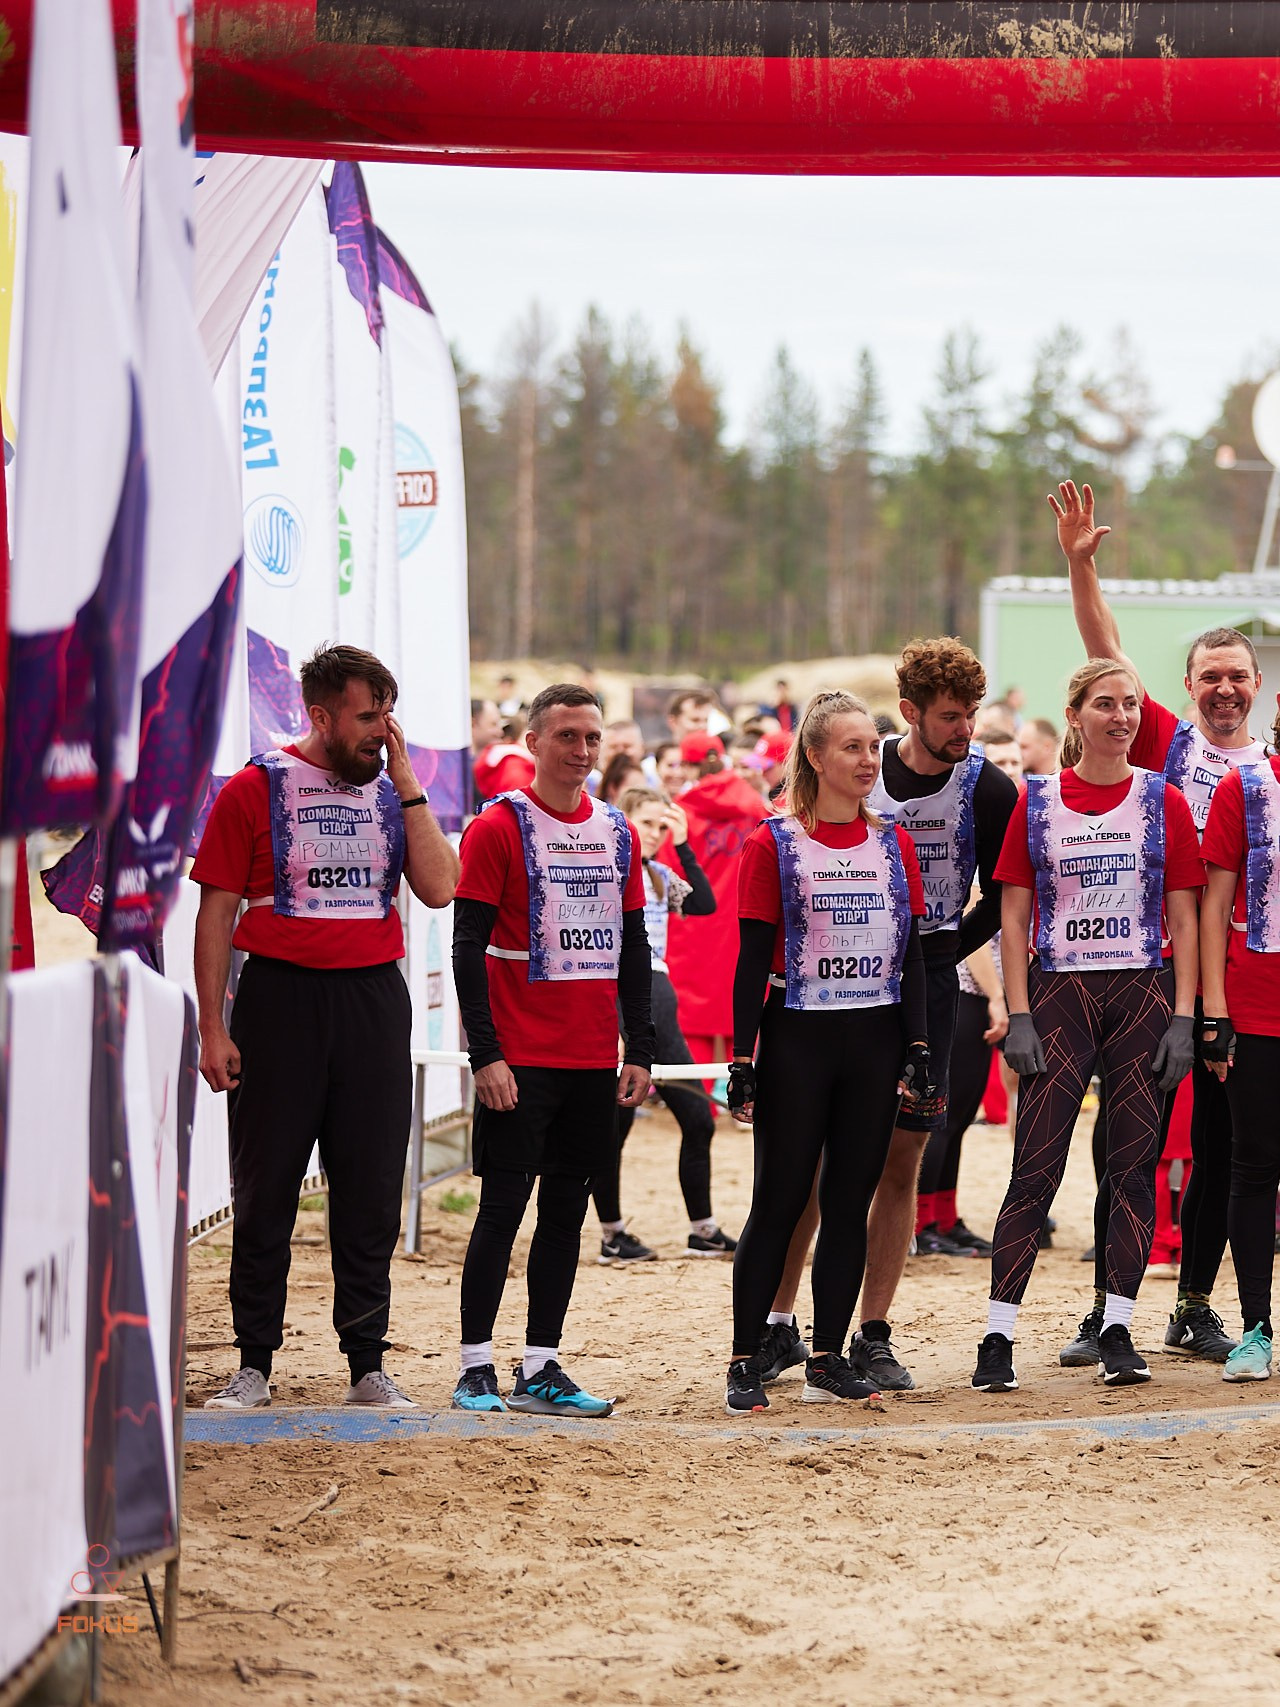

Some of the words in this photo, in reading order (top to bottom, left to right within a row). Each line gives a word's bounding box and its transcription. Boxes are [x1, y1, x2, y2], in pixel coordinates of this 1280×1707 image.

[300, 807, 371, 822] КОМАНДНЫЙ
[321, 822, 353, 834] СТАРТ
[910, 819, 945, 828] ГЕРОЕВ
[1062, 834, 1092, 844] ГОНКА
[1095, 832, 1131, 840] ГЕРОЕВ
[302, 842, 371, 861] РОМАН
[547, 843, 574, 851] ГОНКА
[576, 843, 606, 851] ГЕРОЕВ
[1062, 854, 1134, 875] КОМАНДНЫЙ
[307, 866, 371, 889] 03201
[550, 866, 612, 882] КОМАНДНЫЙ
[1083, 872, 1115, 886] СТАРТ
[567, 882, 596, 896] СТАРТ
[325, 900, 375, 908] ГАЗПРОМБАНК
[813, 894, 883, 910] КОМАНДНЫЙ
[1070, 892, 1128, 911] АЛИНА
[558, 904, 612, 920] РУСЛАН
[835, 910, 866, 923] СТАРТ
[1066, 917, 1131, 941] 03208
[560, 928, 613, 950] 03203
[820, 931, 874, 948] ОЛЬГА
[1083, 950, 1134, 960] ГАЗПРОМБАНК
[818, 956, 883, 979] 03202
[835, 989, 880, 999] ГАЗПРОМБАНК
